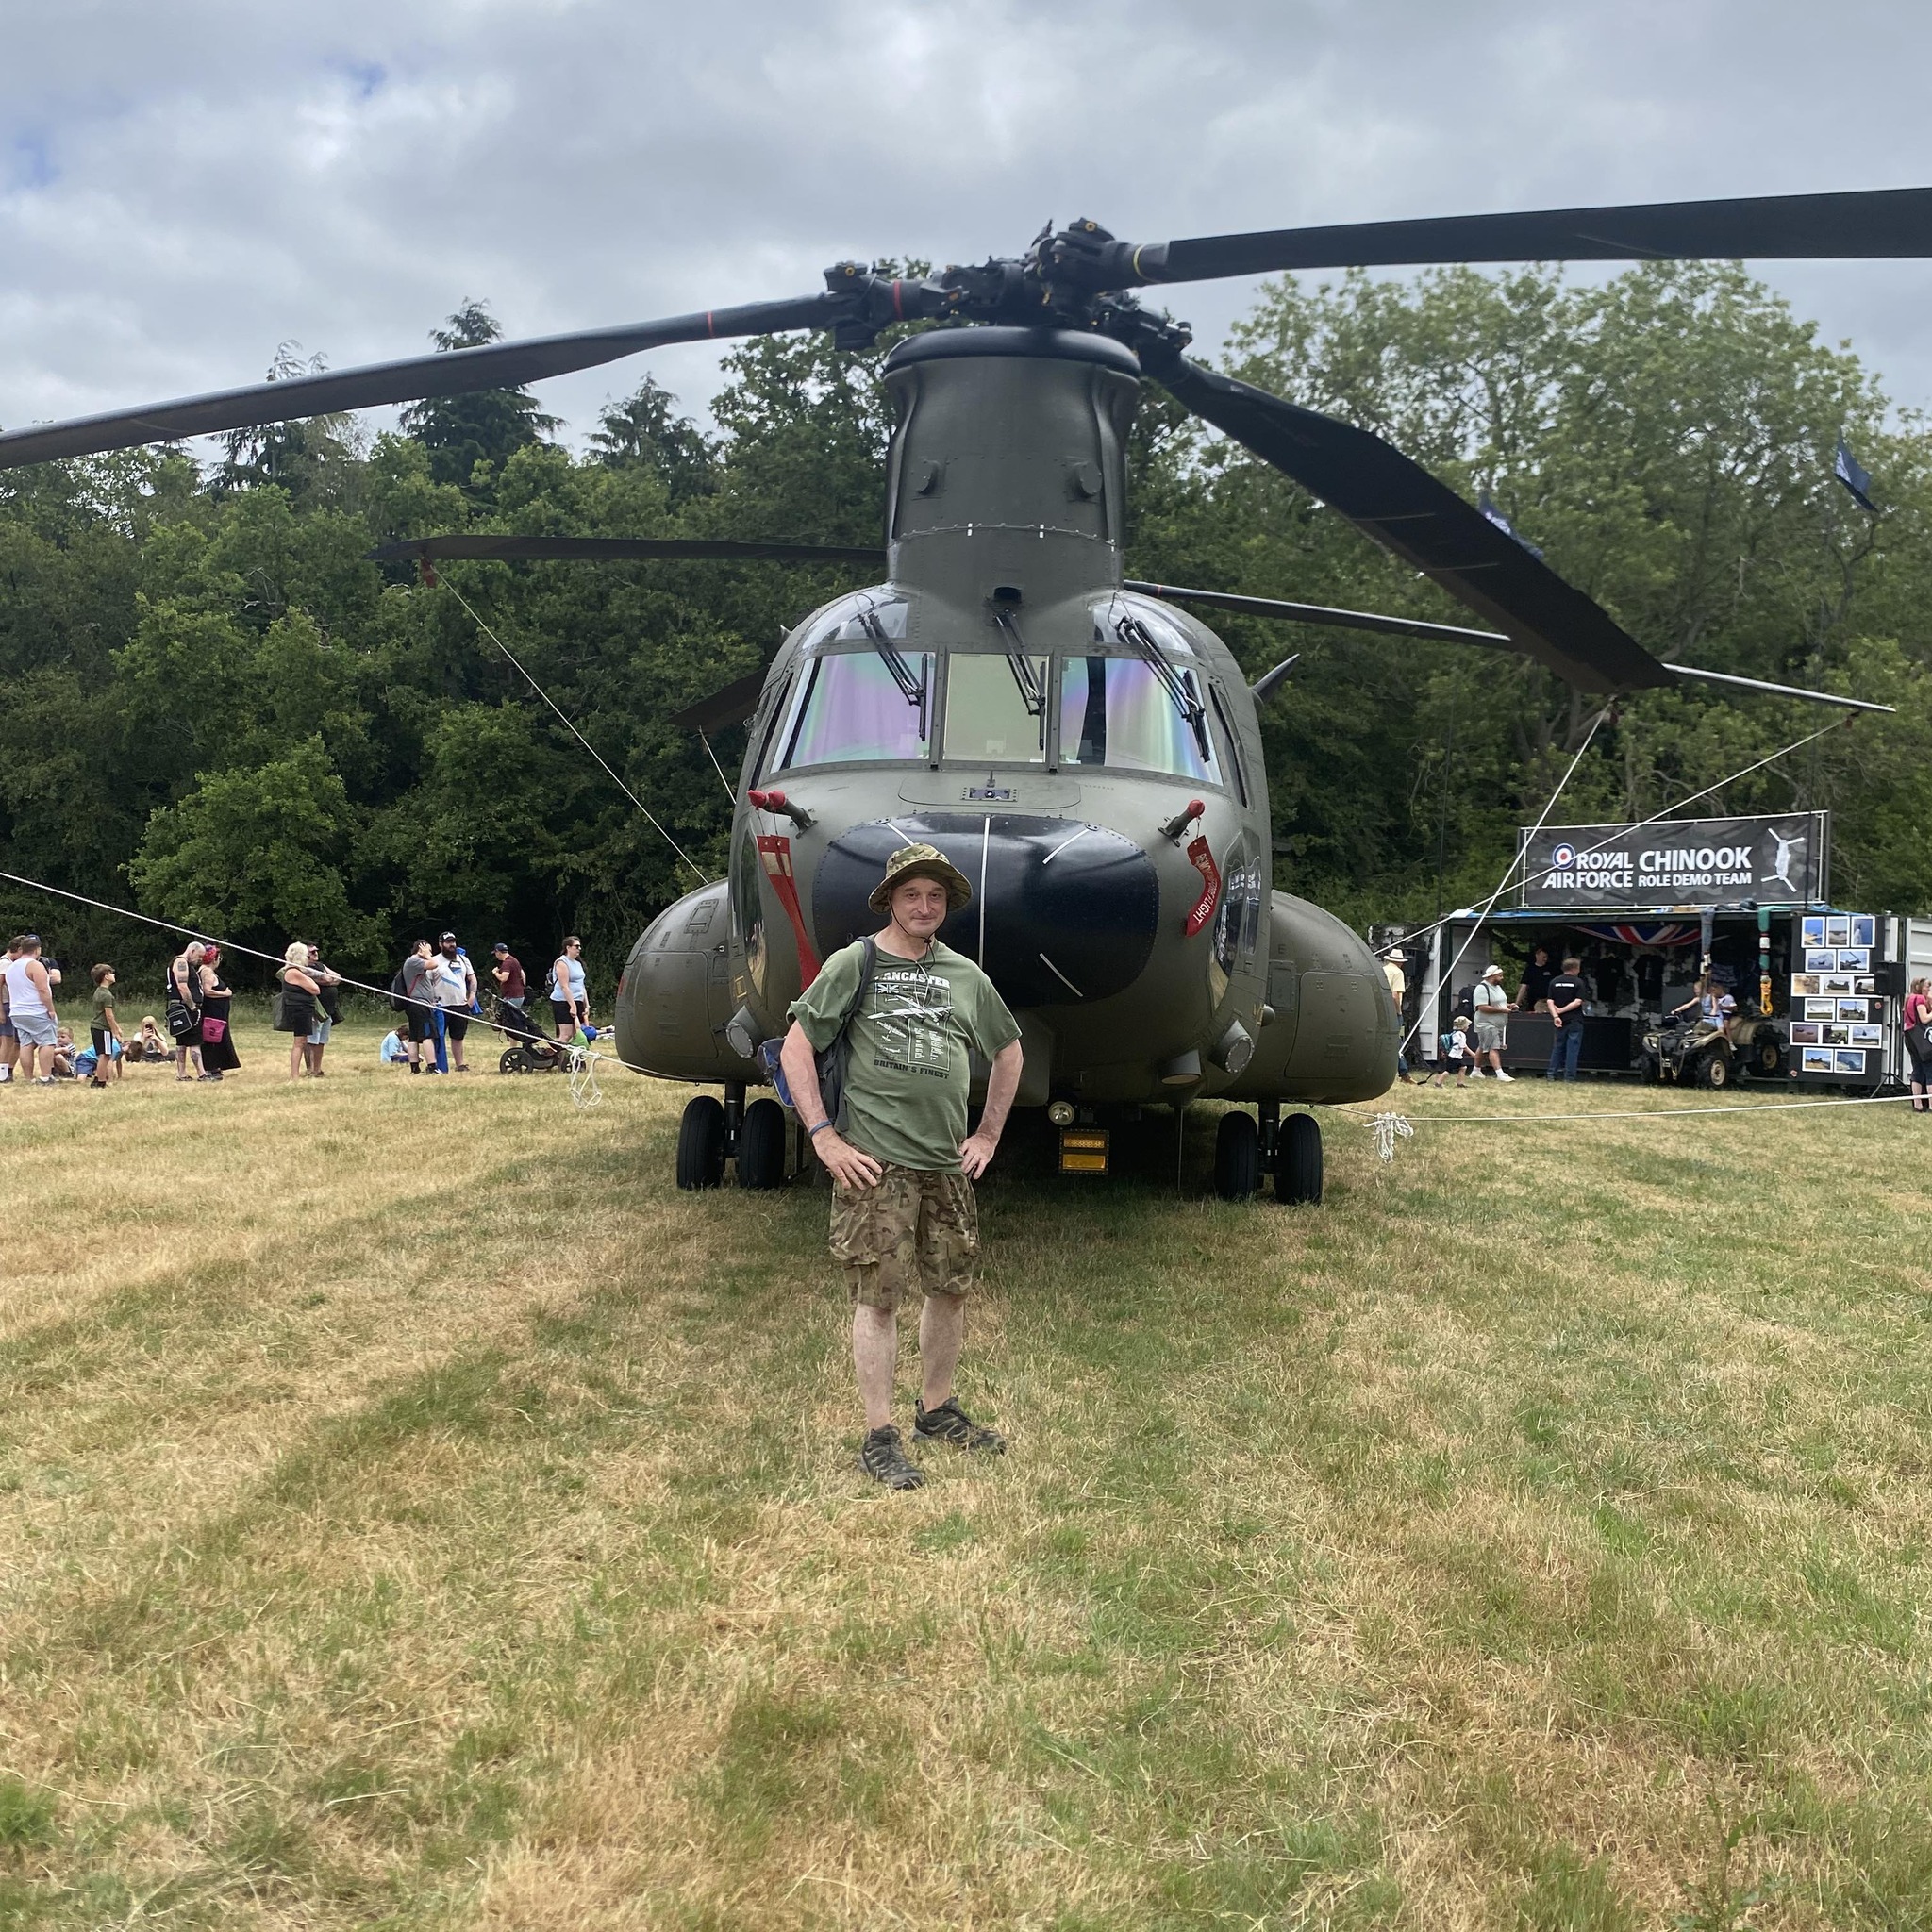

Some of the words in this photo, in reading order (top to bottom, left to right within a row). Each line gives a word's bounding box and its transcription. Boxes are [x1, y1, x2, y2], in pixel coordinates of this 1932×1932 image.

[1576, 851, 1634, 870] ROYAL
[1639, 846, 1753, 873] CHINOOK
[1541, 871, 1574, 889] AIR
[1576, 870, 1634, 889] FORCE
[1638, 874, 1671, 887] ROLE
[1673, 873, 1712, 887] DEMO
[1714, 872, 1753, 885] TEAM
[1192, 892, 1215, 924] FLIGHT
[874, 1059, 918, 1074] BRITAIN'S
[920, 1067, 950, 1079] FINEST
